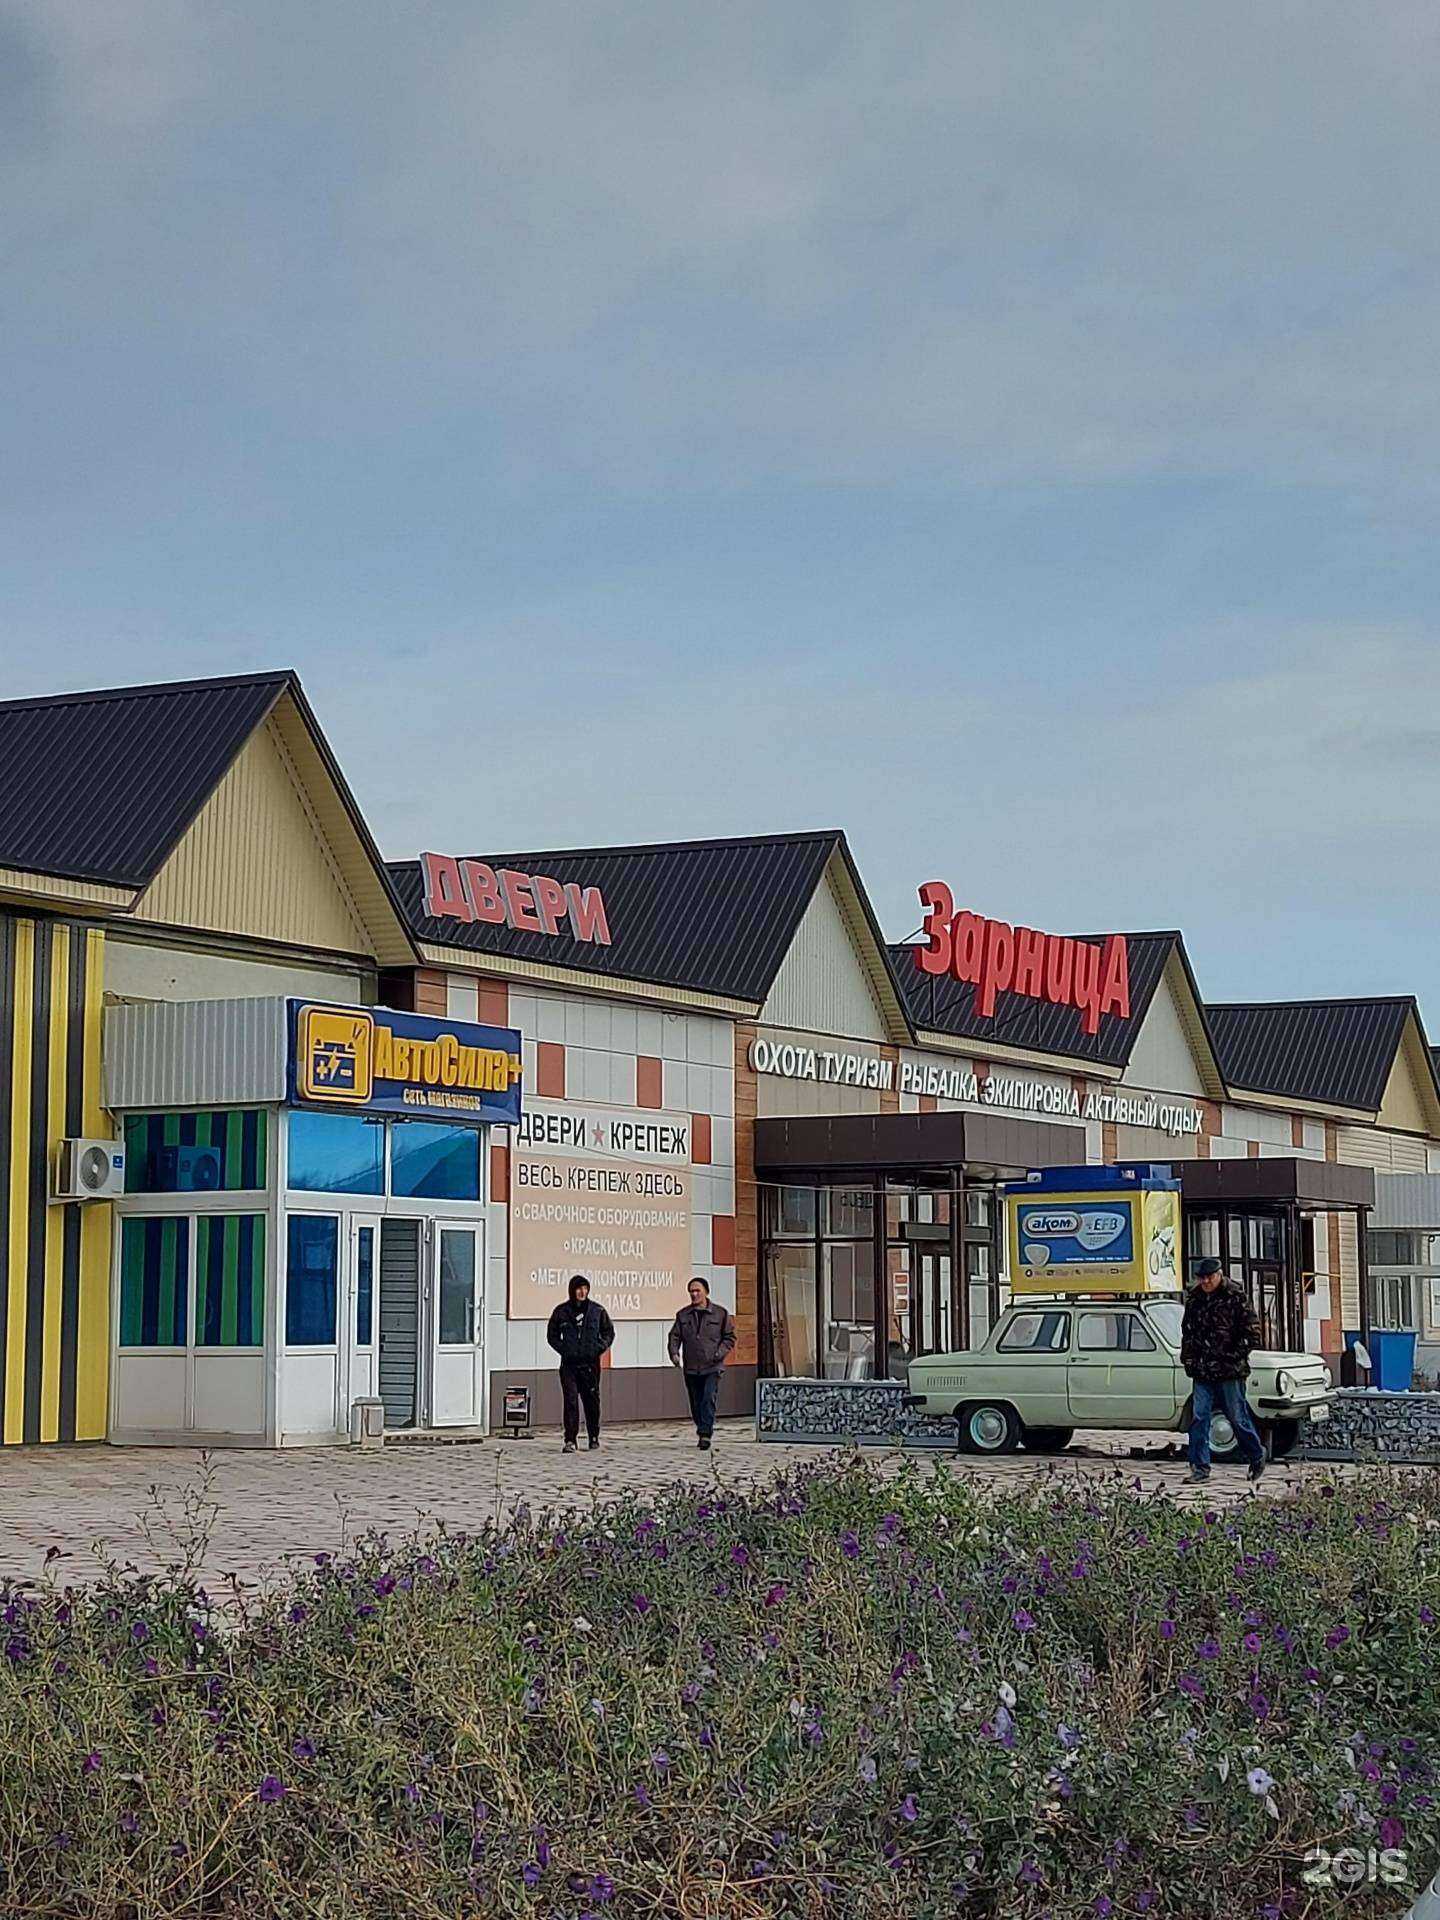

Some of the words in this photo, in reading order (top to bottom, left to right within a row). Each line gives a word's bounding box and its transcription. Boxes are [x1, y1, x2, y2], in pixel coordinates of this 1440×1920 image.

[420, 851, 612, 945] ДВЕРИ
[752, 1038, 818, 1081] ОХОТА
[820, 1051, 893, 1090] ТУРИЗМ
[899, 1062, 979, 1102] РЫБАЛКА
[983, 1075, 1080, 1117] ЭКИПИРОВКА
[1084, 1092, 1158, 1129] АКТИВНЫЙ
[1159, 1105, 1204, 1139] ОТДЫХ
[516, 1112, 586, 1148] ДВЕРИ
[610, 1121, 687, 1155] КРЕПЕЖ
[518, 1163, 563, 1188] ВЕСЬ
[568, 1167, 631, 1194] КРЕПЕЖ
[635, 1172, 683, 1199] ЗДЕСЬ
[522, 1202, 595, 1224] СВАРОЧНОЕ
[597, 1207, 687, 1229] ОБОРУДОВАНИЕ
[570, 1236, 618, 1259] КРАСКИ,
[620, 1239, 645, 1258] САД
